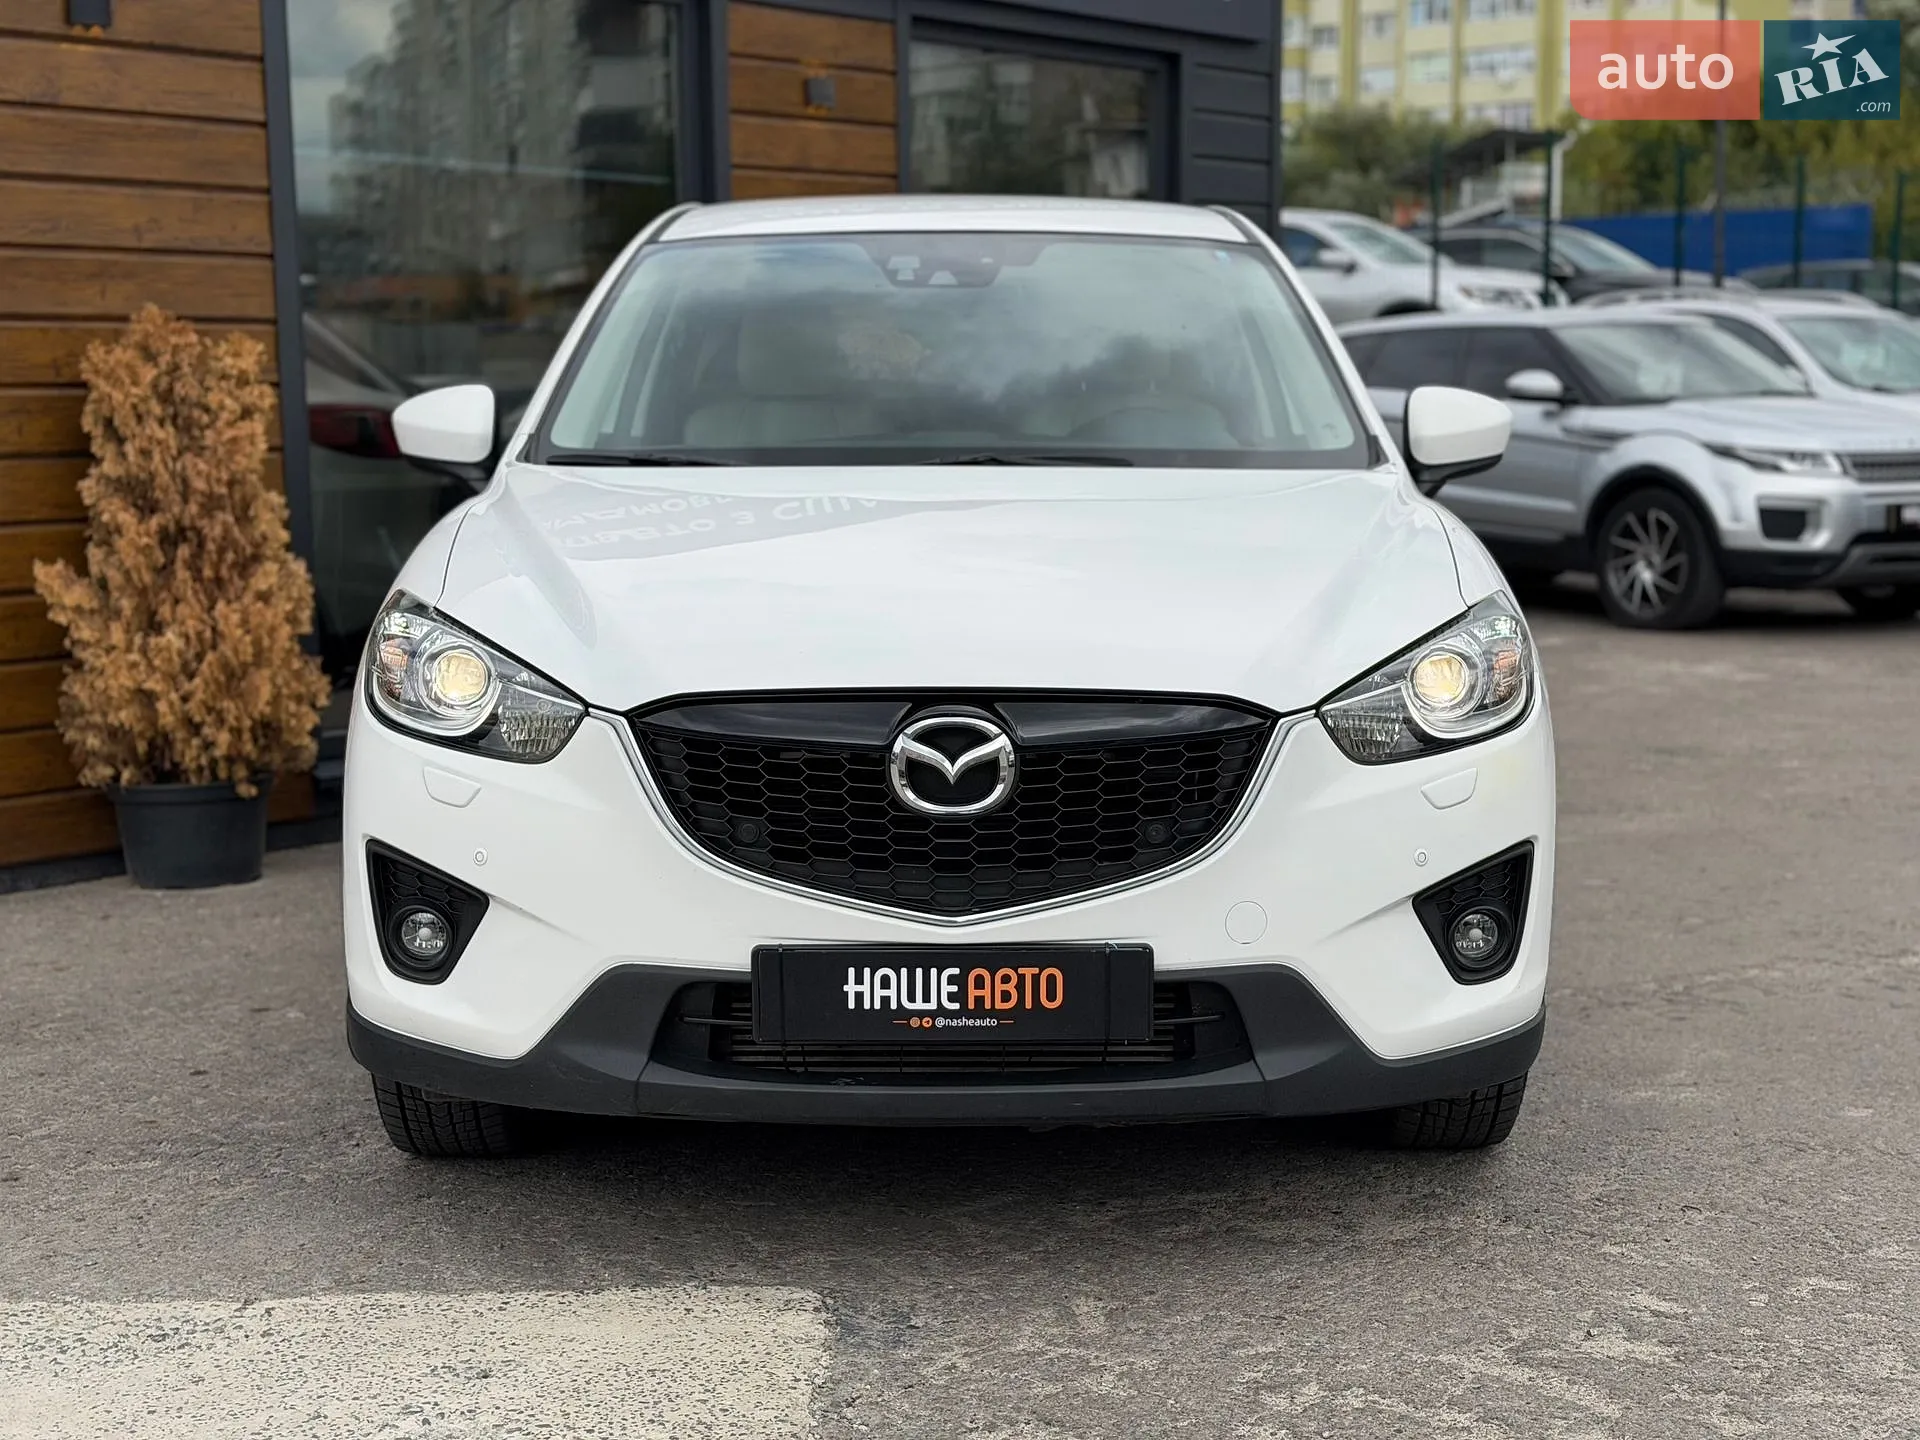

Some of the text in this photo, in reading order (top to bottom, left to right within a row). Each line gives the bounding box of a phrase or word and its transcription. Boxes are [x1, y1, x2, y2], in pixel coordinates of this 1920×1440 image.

[843, 967, 1064, 1010] НАШЕ АВТО
[934, 1015, 998, 1028] @nasheauto
